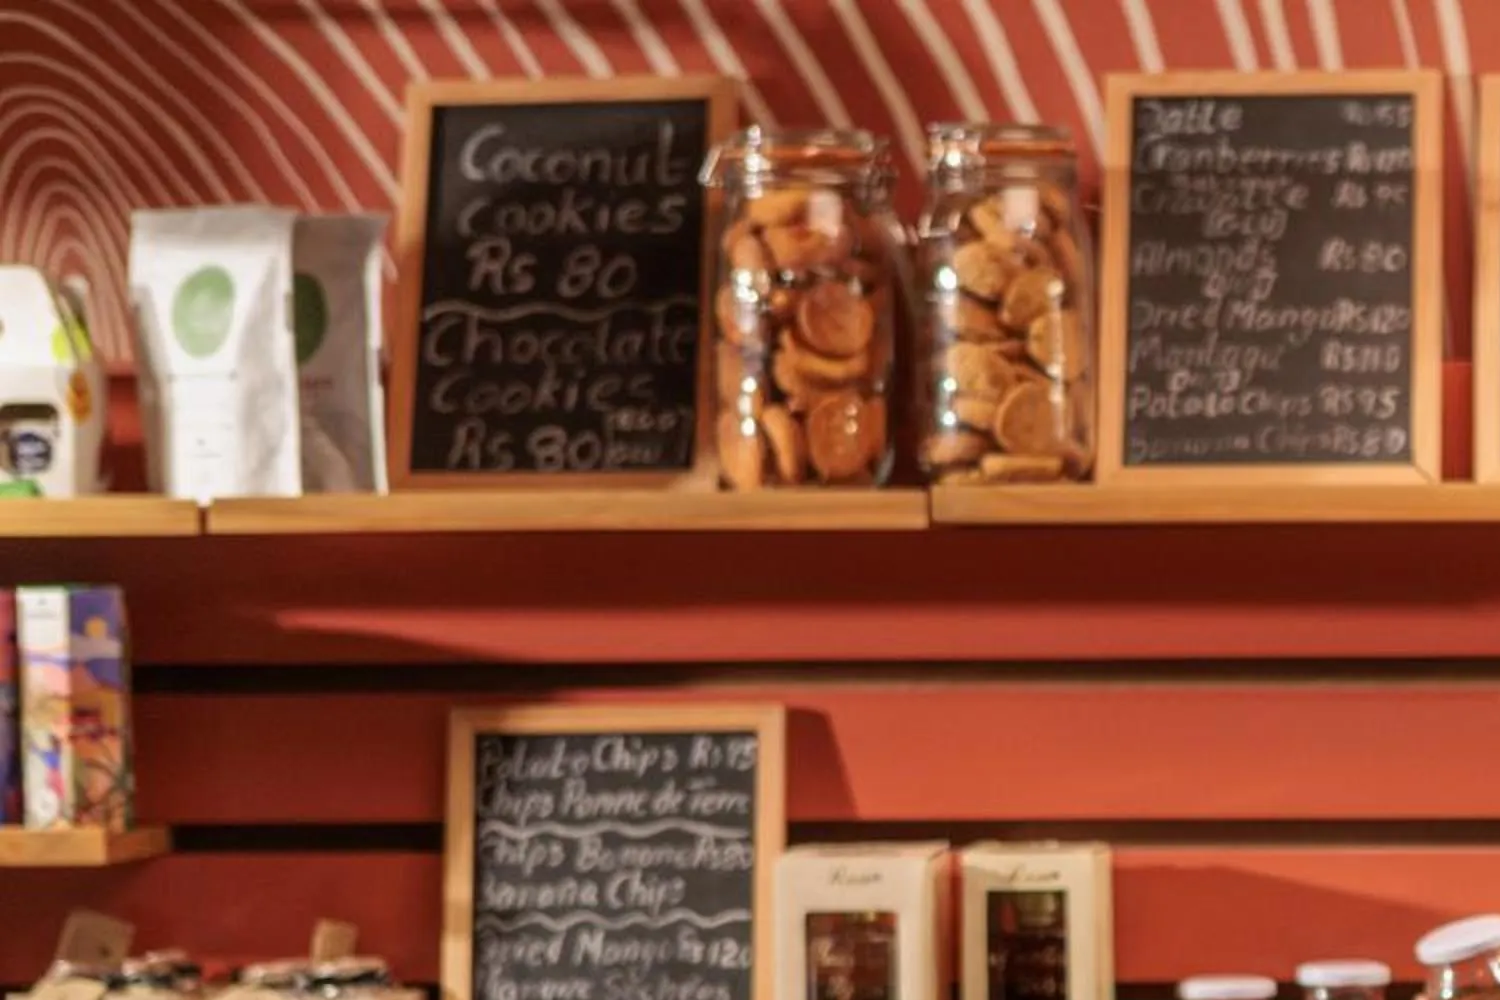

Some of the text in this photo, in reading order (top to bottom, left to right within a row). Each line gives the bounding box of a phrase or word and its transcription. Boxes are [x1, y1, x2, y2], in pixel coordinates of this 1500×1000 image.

[459, 121, 690, 187] Coconut
[466, 234, 639, 299] Rs 80
[447, 416, 518, 472] Rs
[526, 423, 600, 473] 80
